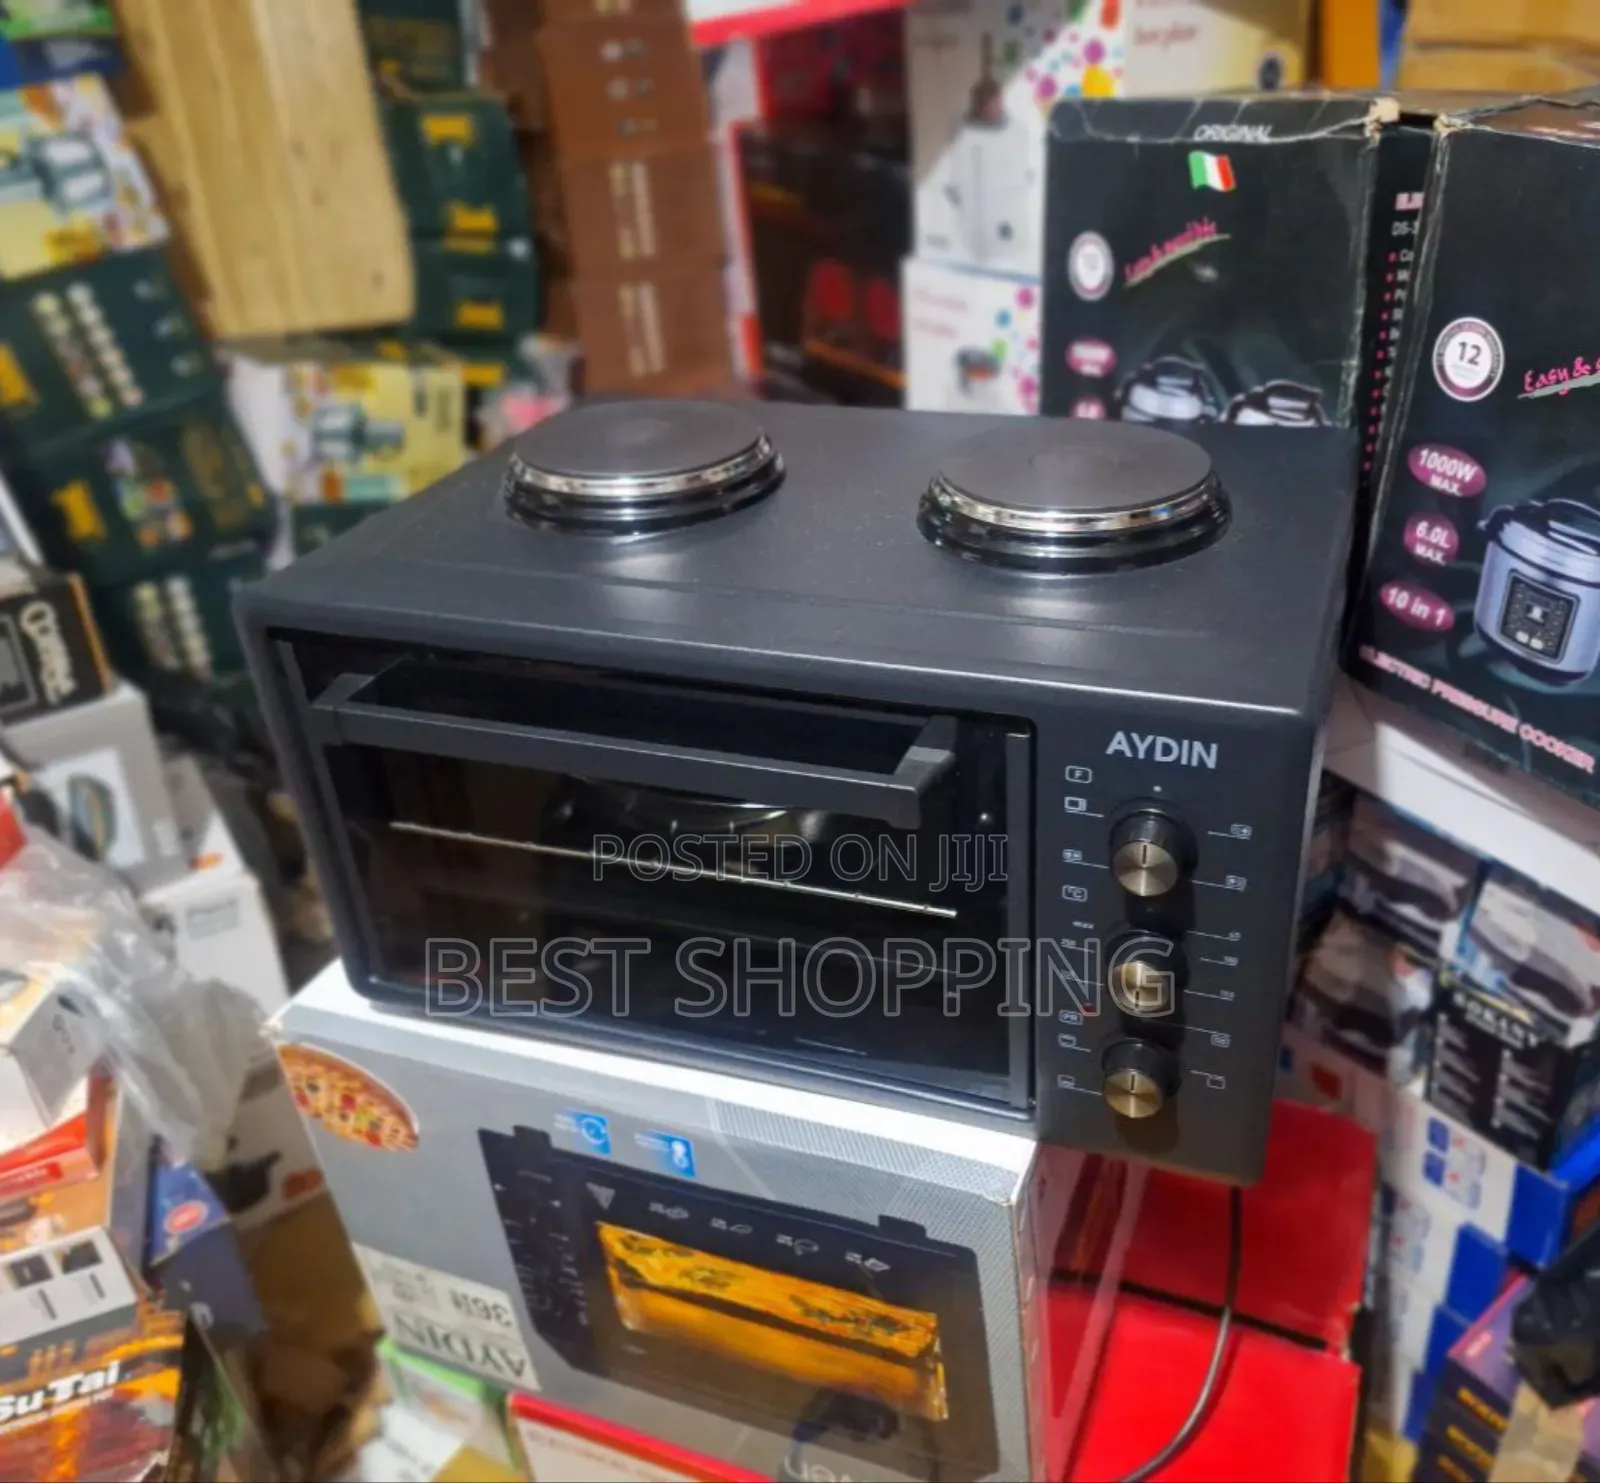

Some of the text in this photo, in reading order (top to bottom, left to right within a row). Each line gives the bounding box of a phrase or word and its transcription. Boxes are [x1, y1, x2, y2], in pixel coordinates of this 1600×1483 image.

[1458, 341, 1482, 367] 12
[1419, 447, 1478, 483] 1000W
[1387, 587, 1410, 610] 10
[1435, 608, 1447, 627] 1
[1105, 730, 1219, 770] AYDIN
[1518, 722, 1596, 774] COOKER
